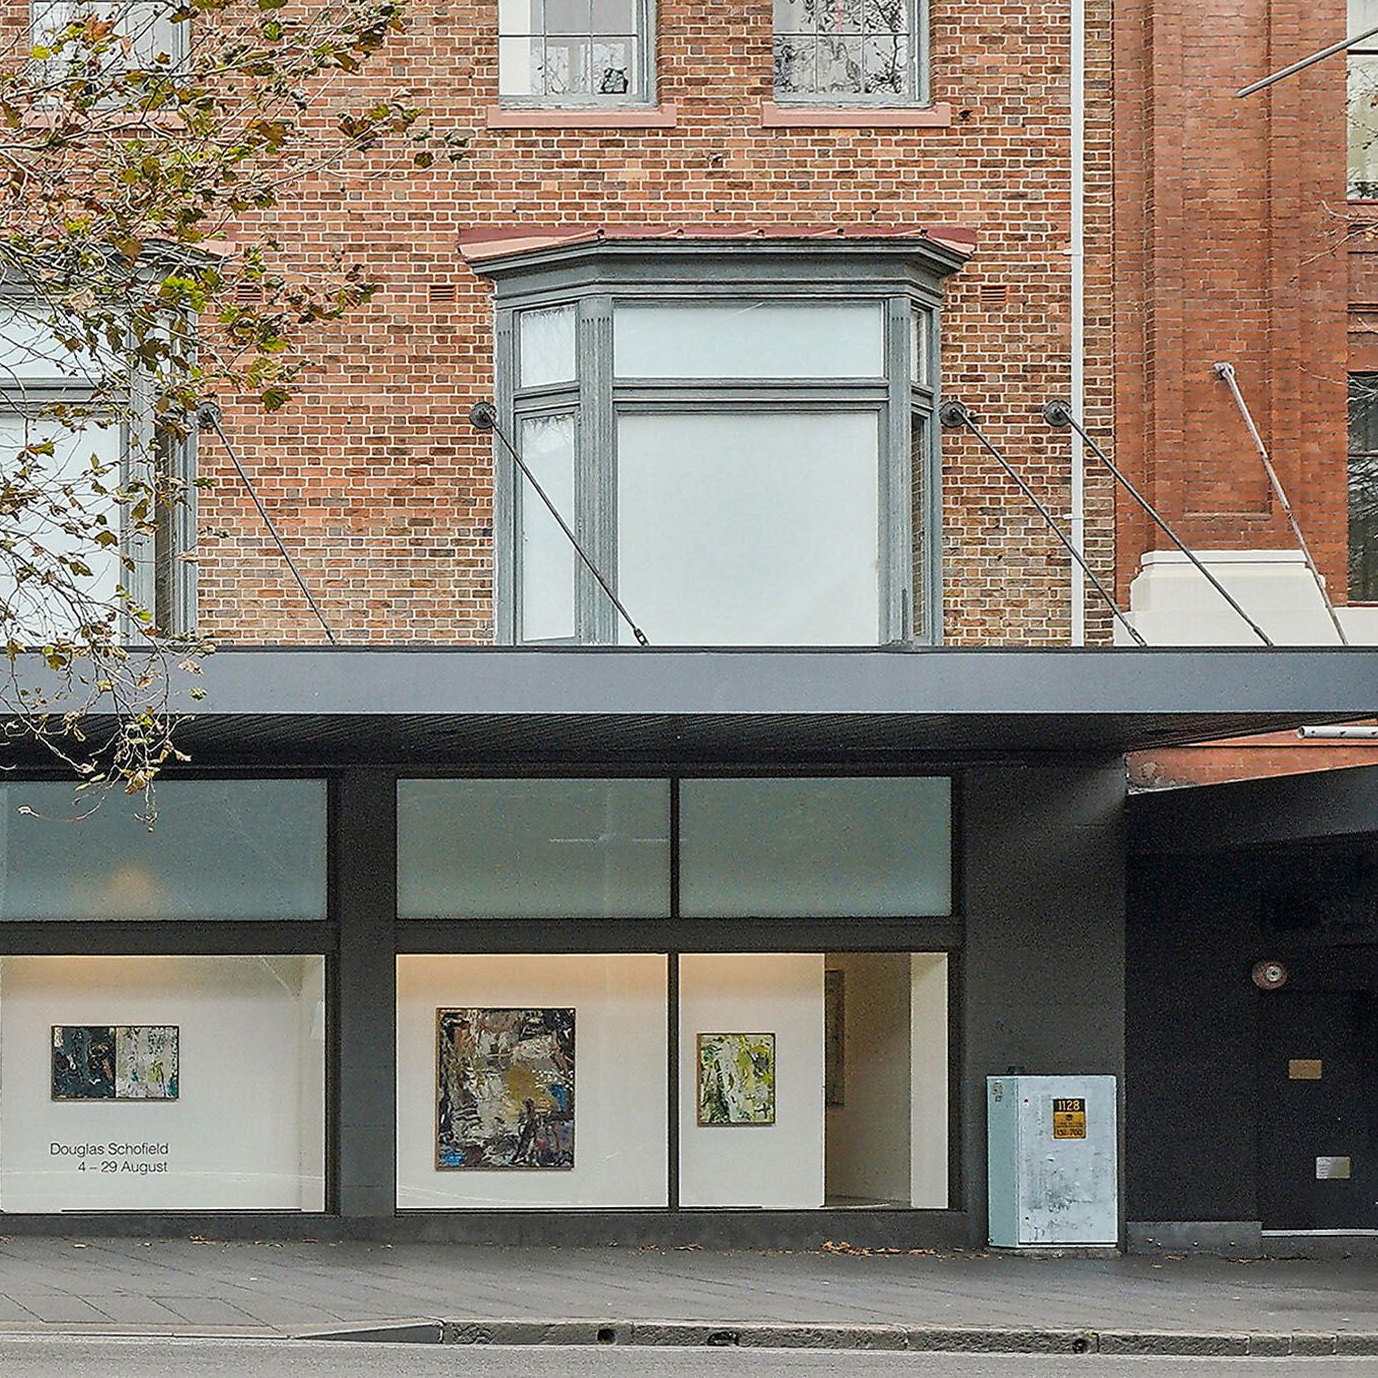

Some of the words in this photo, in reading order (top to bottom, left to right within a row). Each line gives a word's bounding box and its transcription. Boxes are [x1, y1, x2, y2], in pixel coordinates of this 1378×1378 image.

[1058, 1100, 1080, 1111] 1128
[50, 1142, 104, 1158] Douglas
[107, 1142, 169, 1155] Schofield
[77, 1161, 86, 1172] 4
[100, 1161, 118, 1173] 29
[120, 1160, 168, 1175] August
